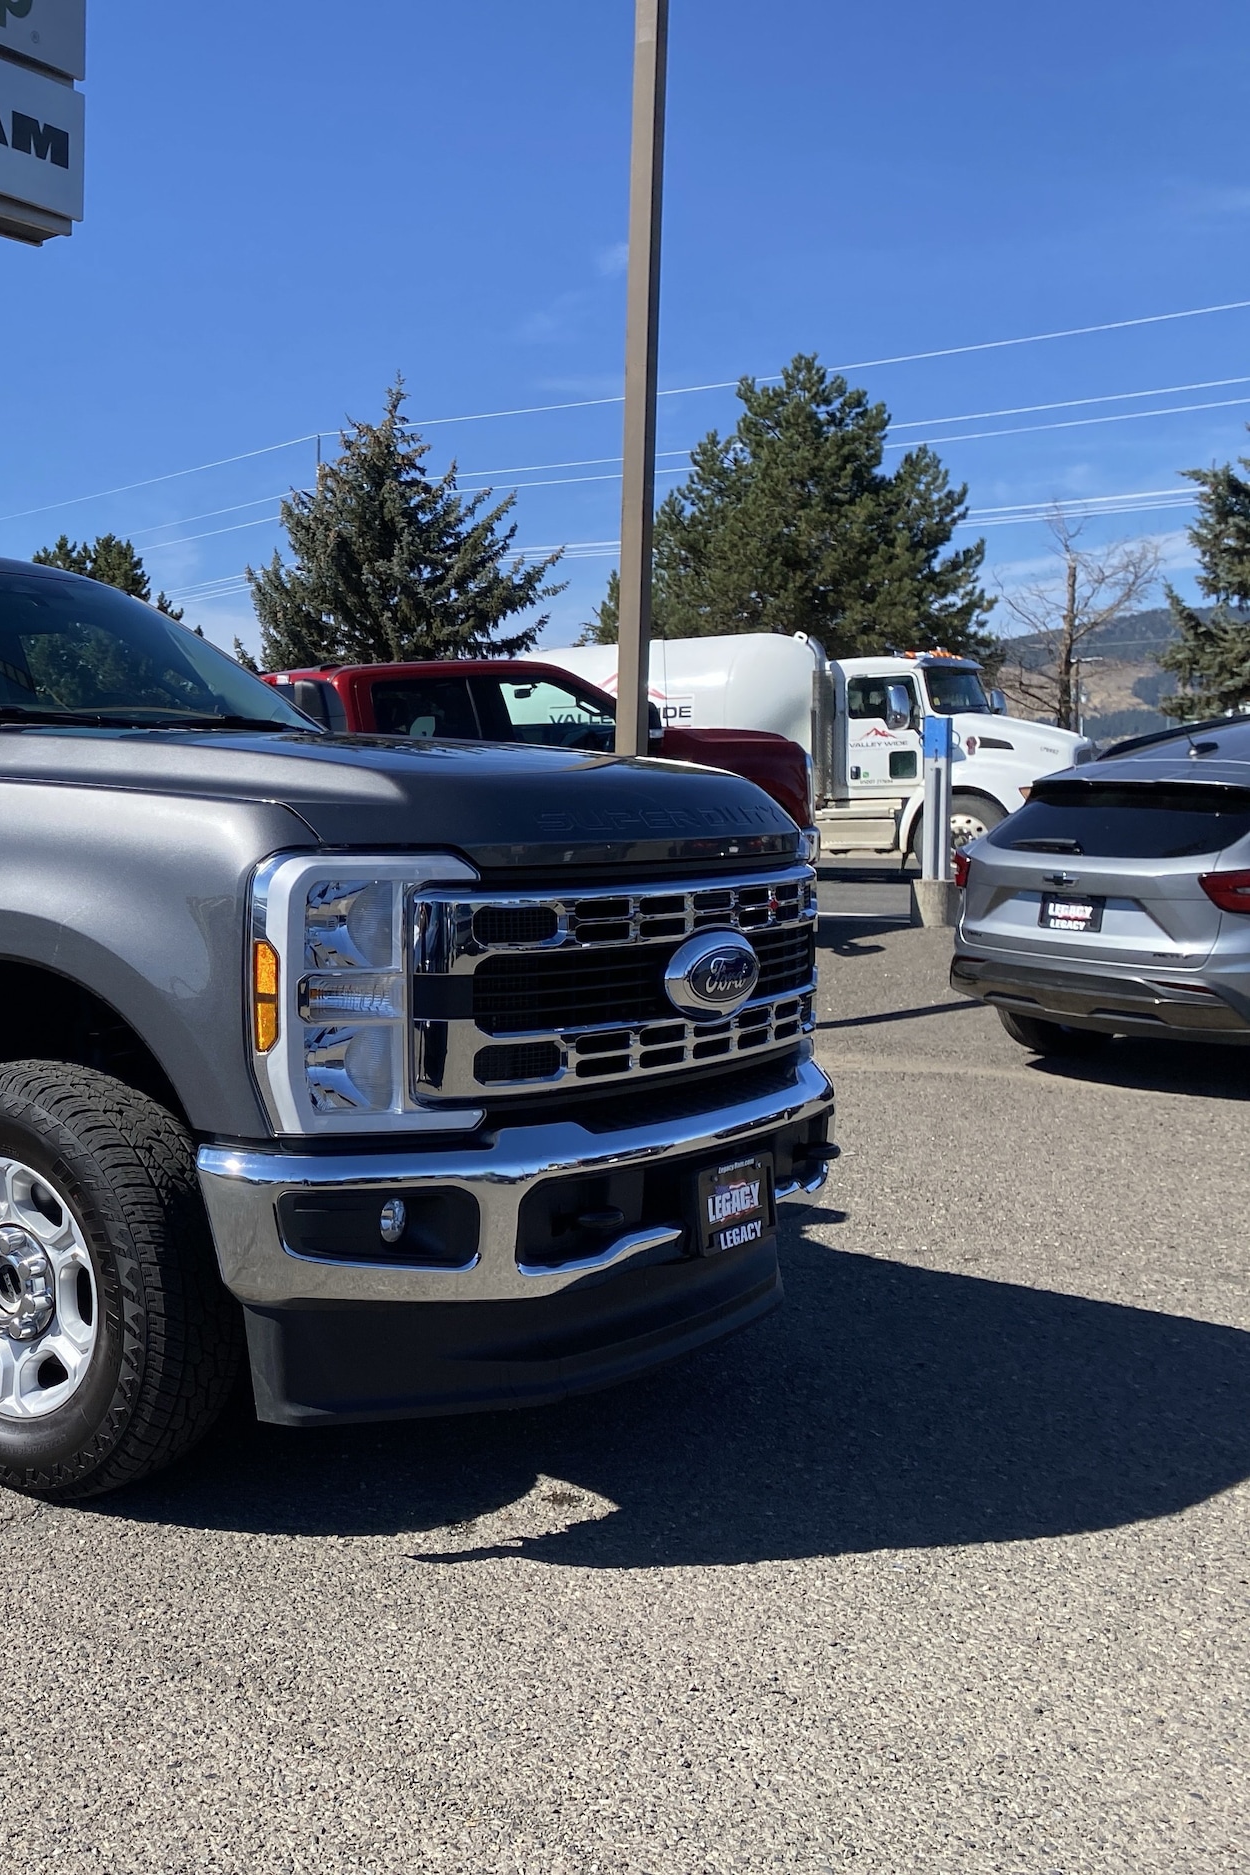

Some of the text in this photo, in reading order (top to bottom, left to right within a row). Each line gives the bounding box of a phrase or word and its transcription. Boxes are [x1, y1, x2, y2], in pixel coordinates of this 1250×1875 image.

[549, 706, 692, 724] VALLE IDE
[538, 805, 780, 831] SUPER DUTY
[1048, 902, 1094, 919] LEGACY
[1050, 918, 1086, 931] LEGACY
[706, 956, 748, 994] Ford
[707, 1180, 761, 1224] LEGACY
[719, 1221, 762, 1250] LEGACY
